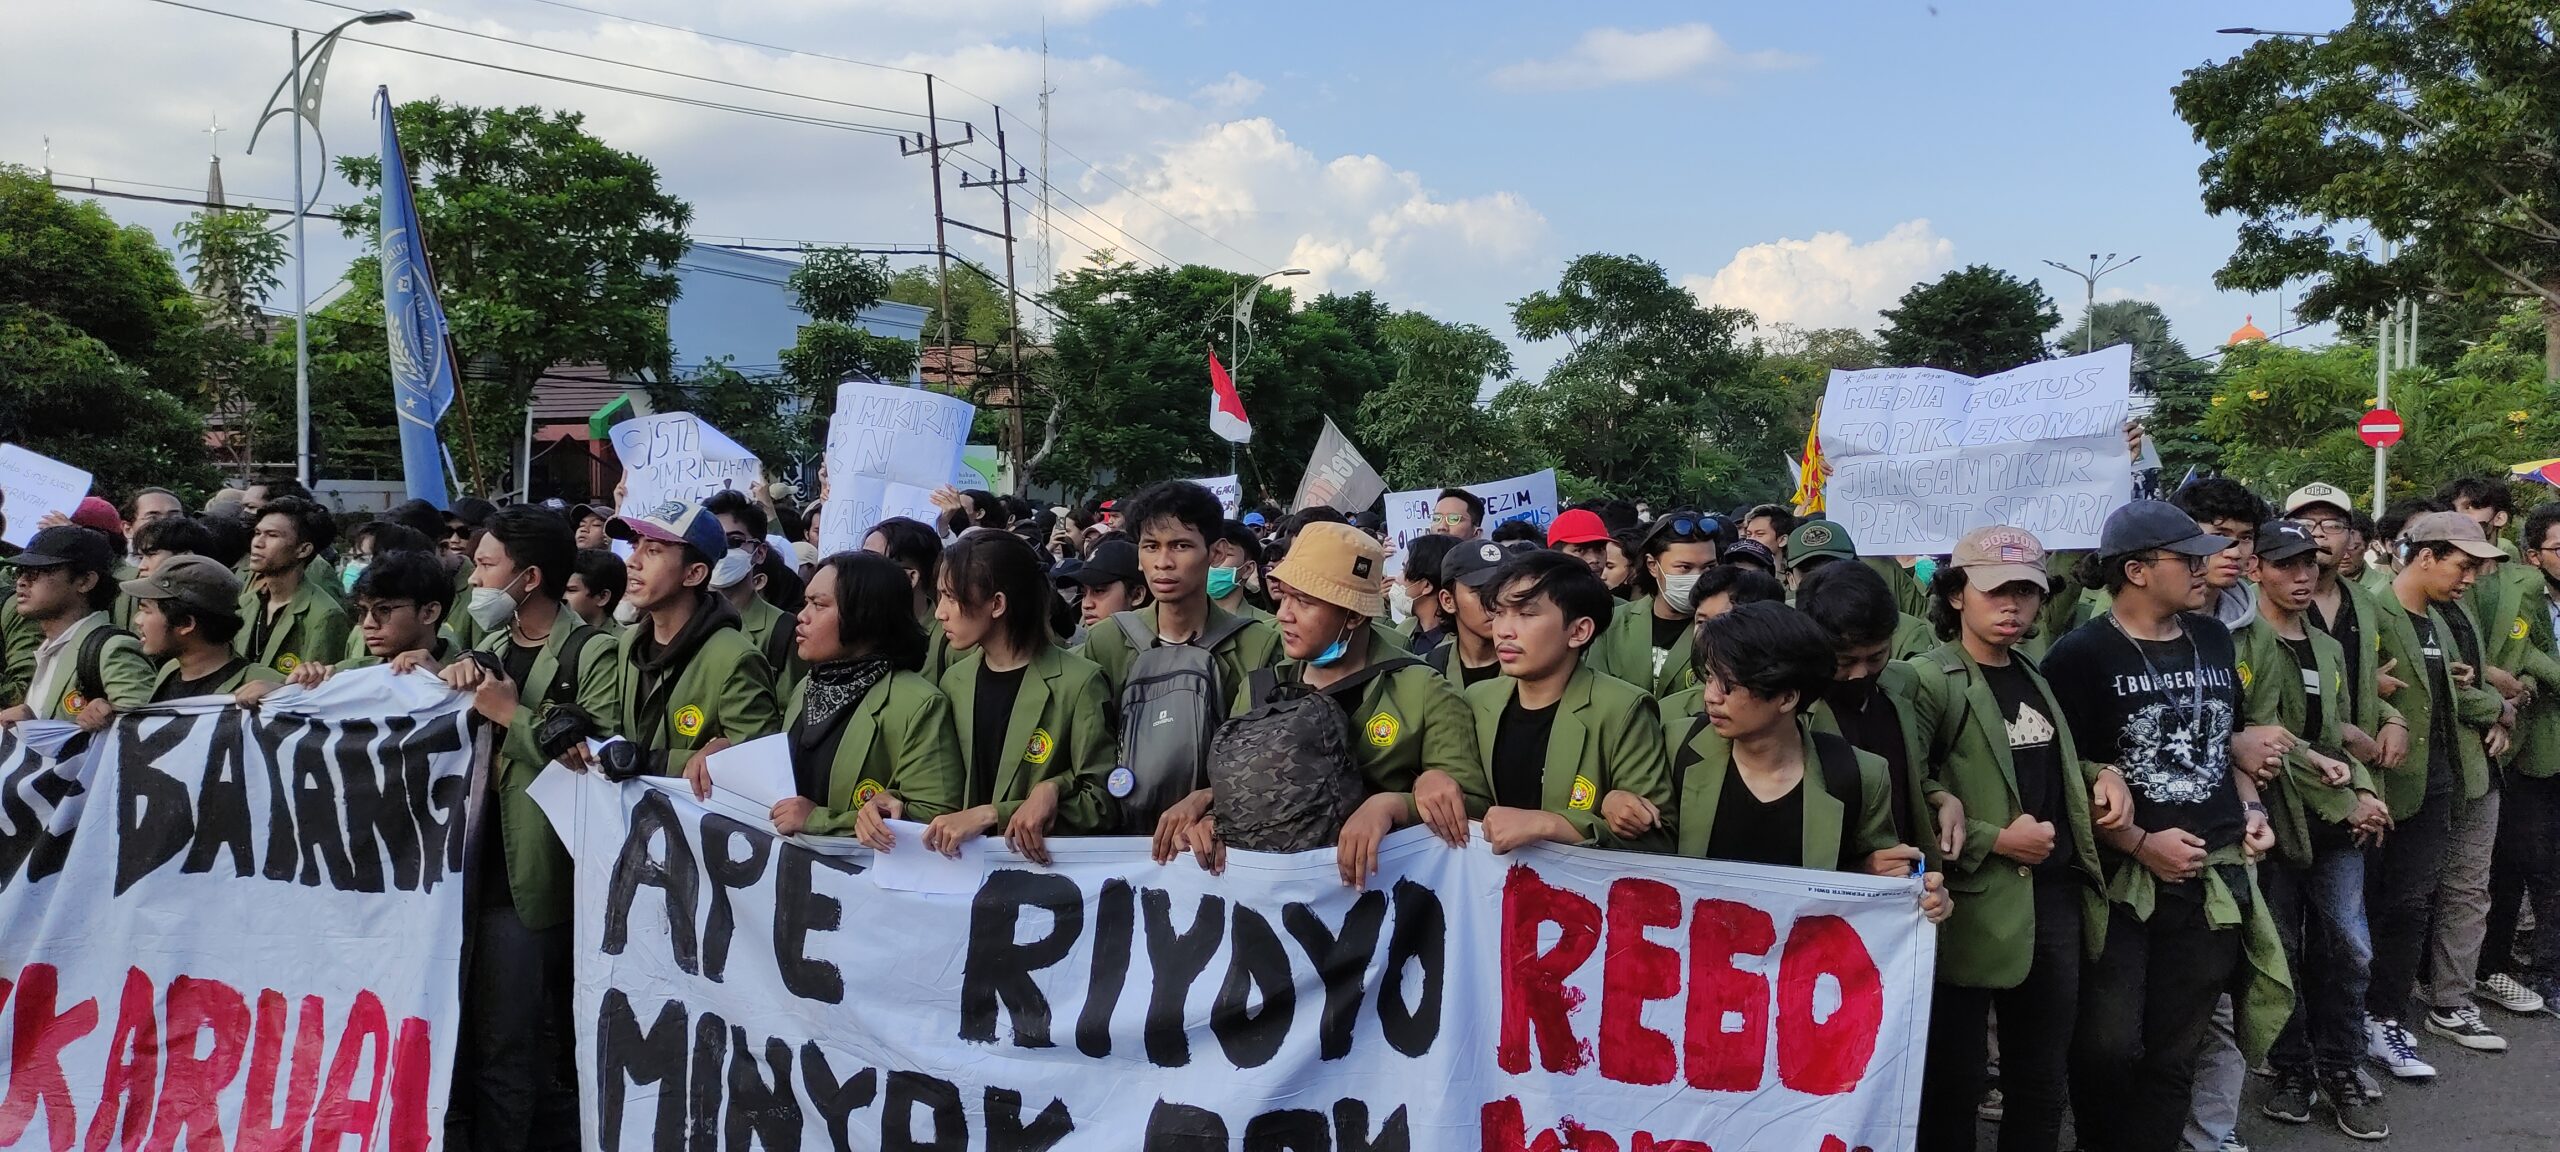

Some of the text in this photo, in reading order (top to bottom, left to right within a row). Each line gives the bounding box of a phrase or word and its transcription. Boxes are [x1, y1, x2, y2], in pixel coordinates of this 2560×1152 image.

[1843, 367, 2105, 413] MEDIA FOKUS
[857, 395, 968, 446] MIKIRIN
[1839, 399, 2124, 457] TOPIK EKONOMI
[1841, 446, 2095, 502] JANGAN PIKIR
[1851, 501, 1973, 547] PERUT
[1984, 492, 2113, 537] SENDIRI
[1980, 531, 2038, 554] BOSTON
[114, 704, 469, 897] BAYANG
[601, 788, 866, 1005] APE
[957, 868, 1447, 1070] RIYOYO
